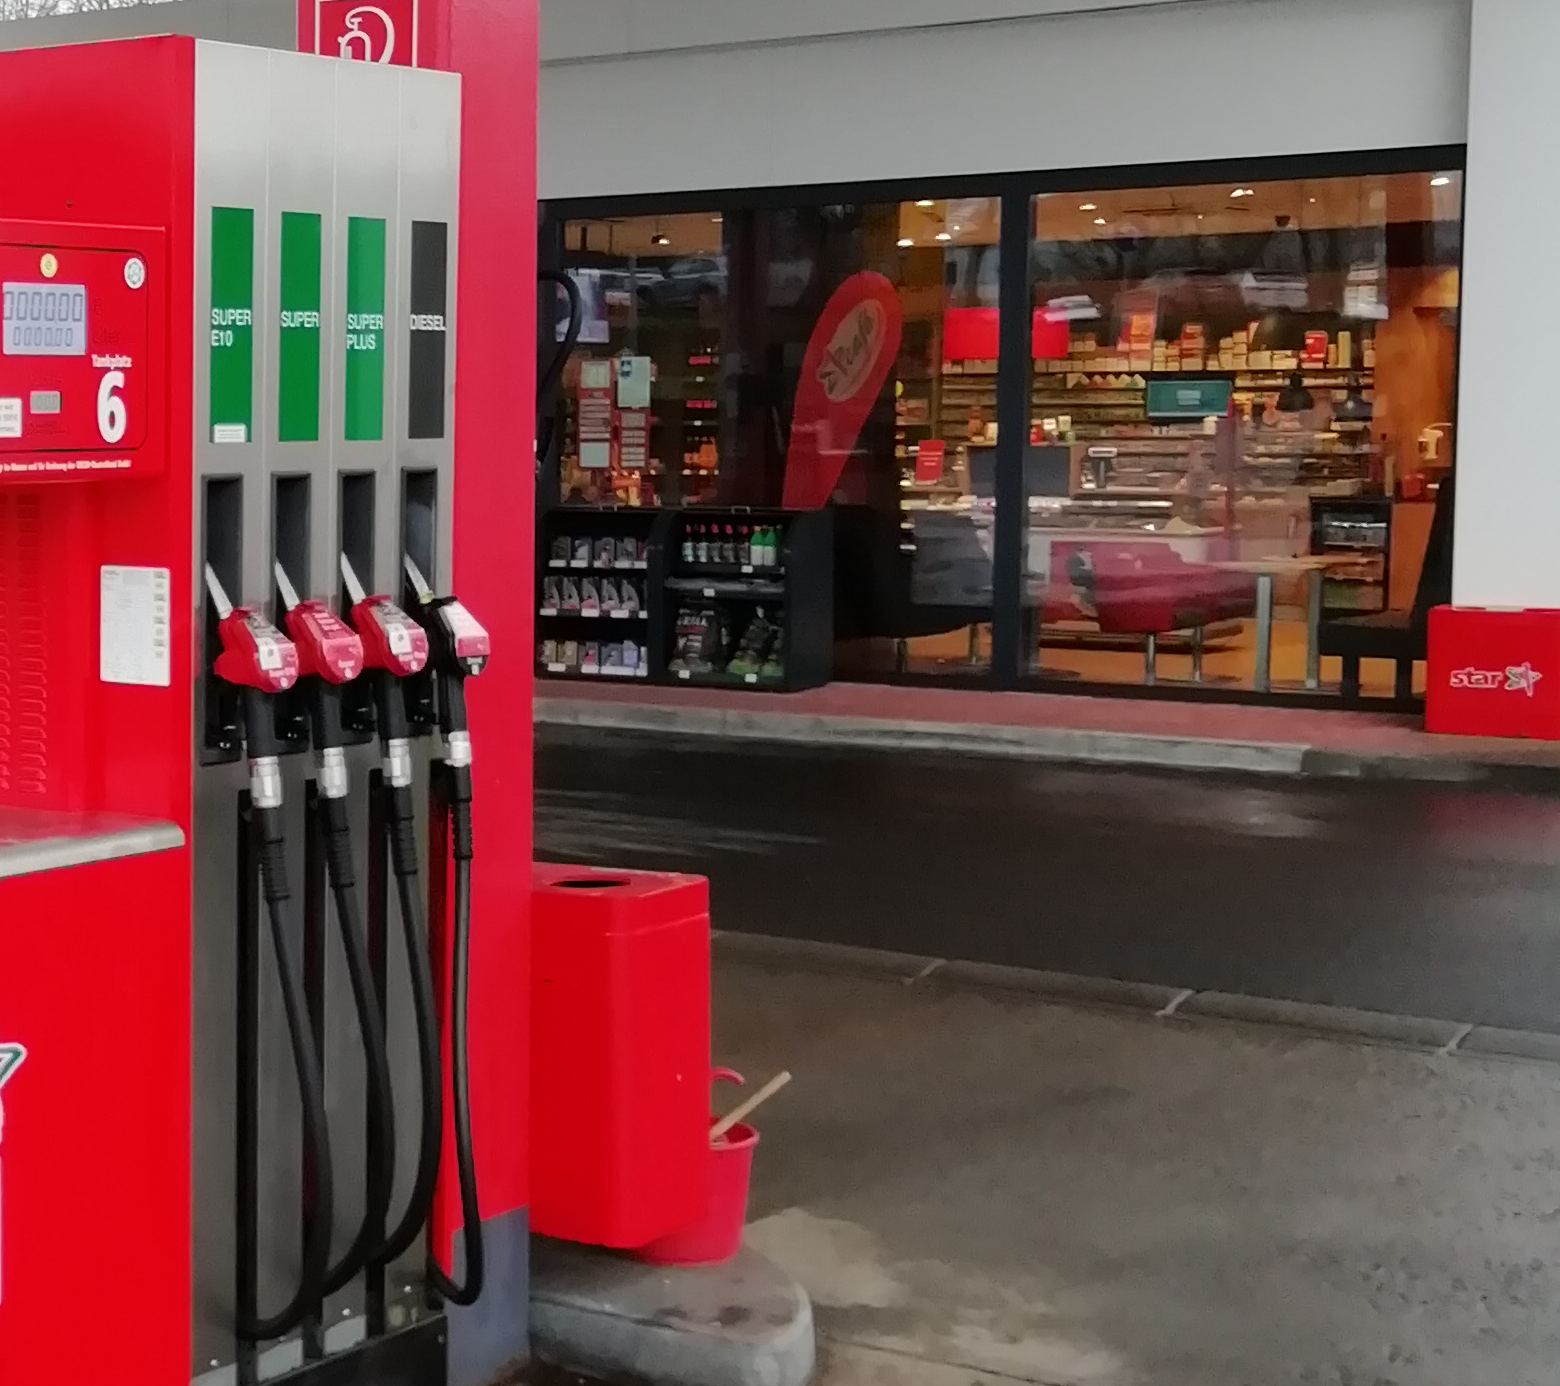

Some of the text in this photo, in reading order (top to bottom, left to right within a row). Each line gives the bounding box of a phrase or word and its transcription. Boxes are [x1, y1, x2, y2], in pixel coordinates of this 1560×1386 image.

[211, 309, 252, 326] SUPER
[280, 311, 320, 328] SUPER
[347, 314, 384, 330] SUPER
[409, 314, 447, 331] DIESEL
[211, 330, 233, 346] E10
[346, 334, 376, 350] PLUS
[97, 370, 127, 443] 6
[1450, 667, 1503, 688] star
